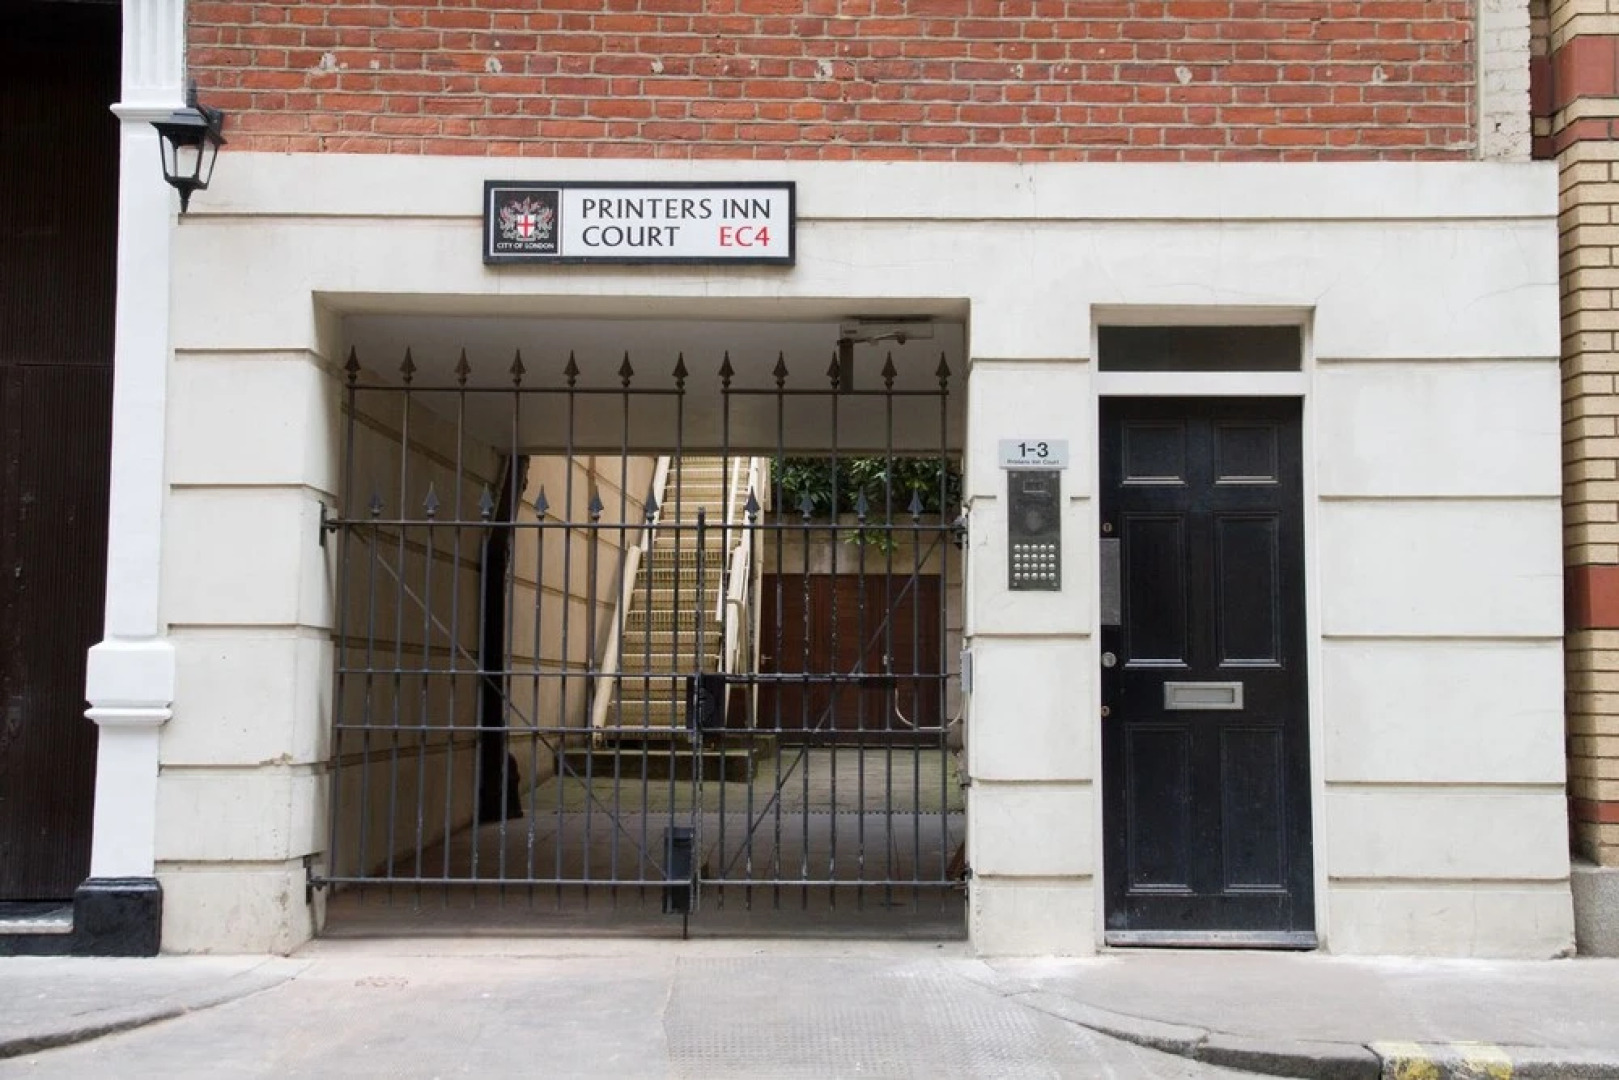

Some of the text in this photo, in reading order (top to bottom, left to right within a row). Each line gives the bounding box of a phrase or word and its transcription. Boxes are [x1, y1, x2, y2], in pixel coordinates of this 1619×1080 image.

[582, 198, 771, 219] PRINTERS INN
[582, 226, 770, 247] COURT EC4
[1018, 442, 1049, 457] 1-3
